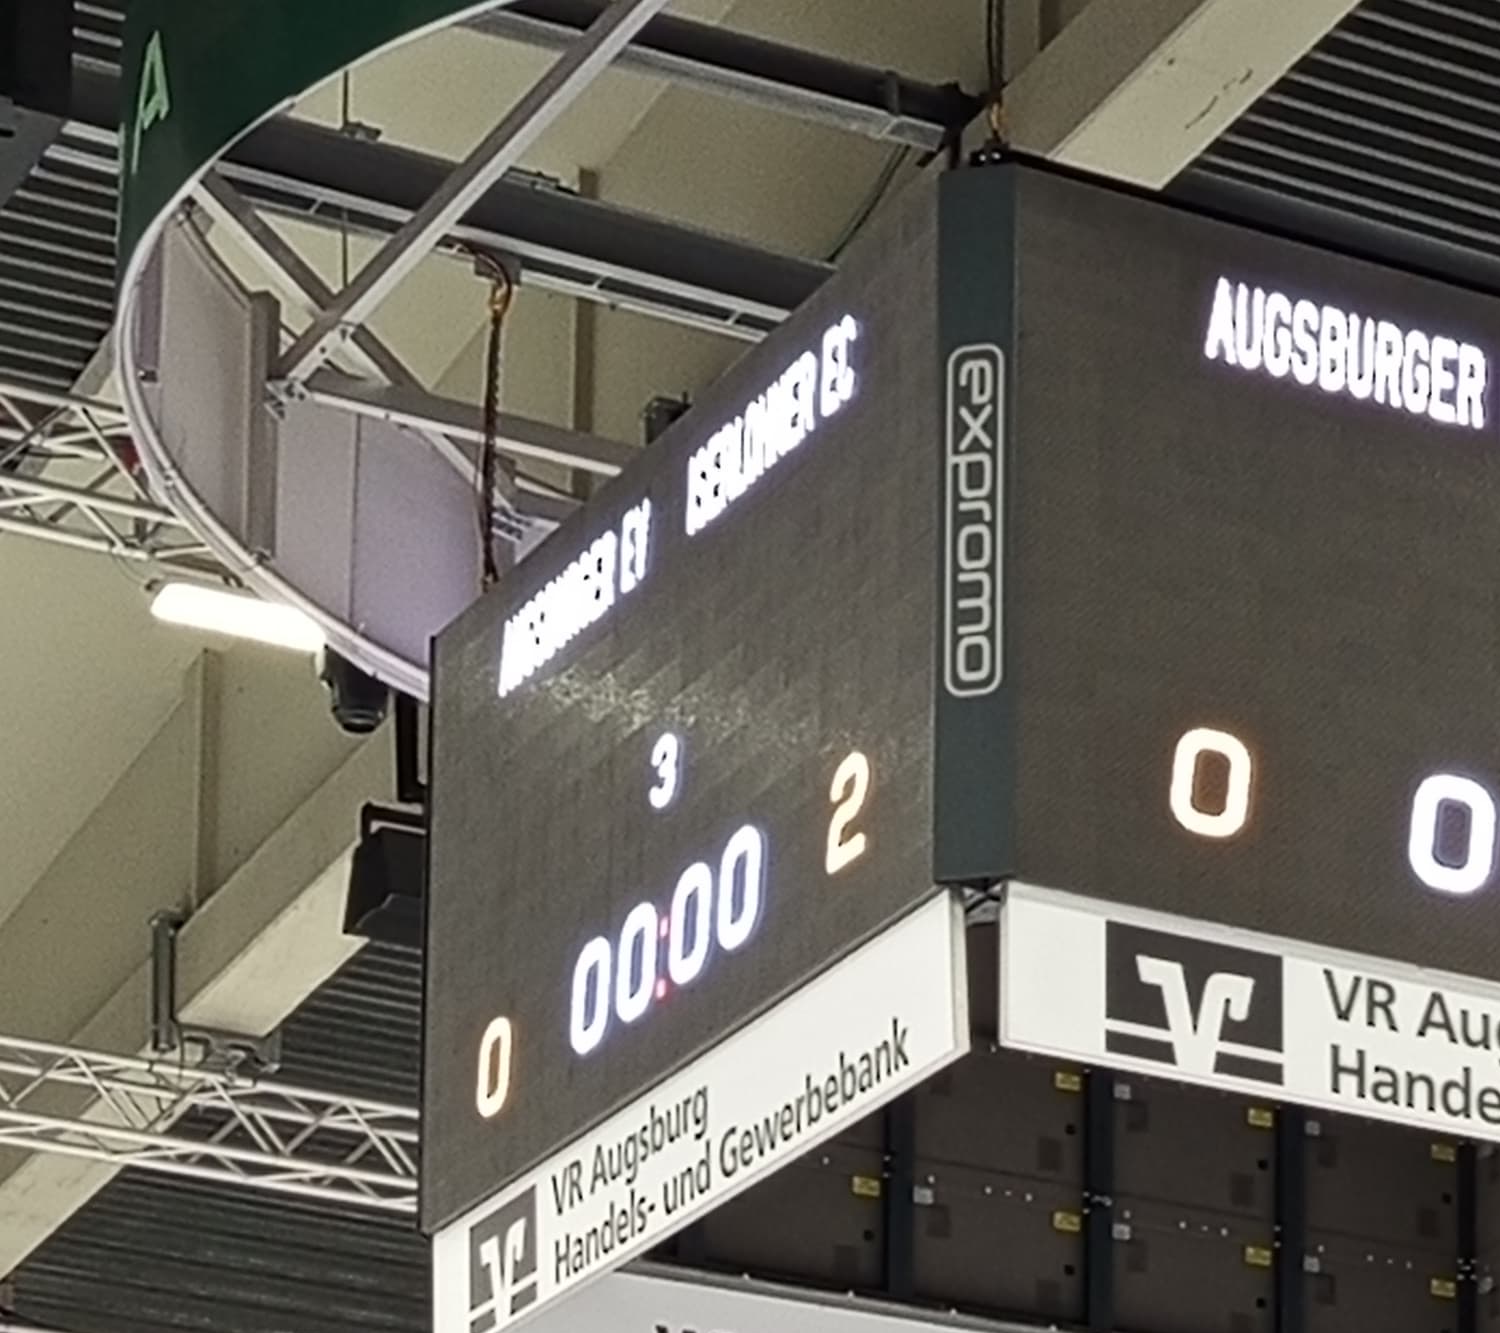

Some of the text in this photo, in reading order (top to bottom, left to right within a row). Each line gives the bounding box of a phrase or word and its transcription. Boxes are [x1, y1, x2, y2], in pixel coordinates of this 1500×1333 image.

[1205, 277, 1486, 429] AUGSBURGER
[950, 359, 993, 682] expromo
[648, 732, 679, 809] 3
[825, 750, 870, 875] 2
[1170, 727, 1251, 837] 0
[569, 824, 763, 1056] 00:00
[1323, 969, 1398, 1032] VR
[476, 1016, 512, 1118] 0
[550, 1084, 709, 1217] VR Augsburg
[553, 1017, 910, 1284] Handels- und Gewerbebank
